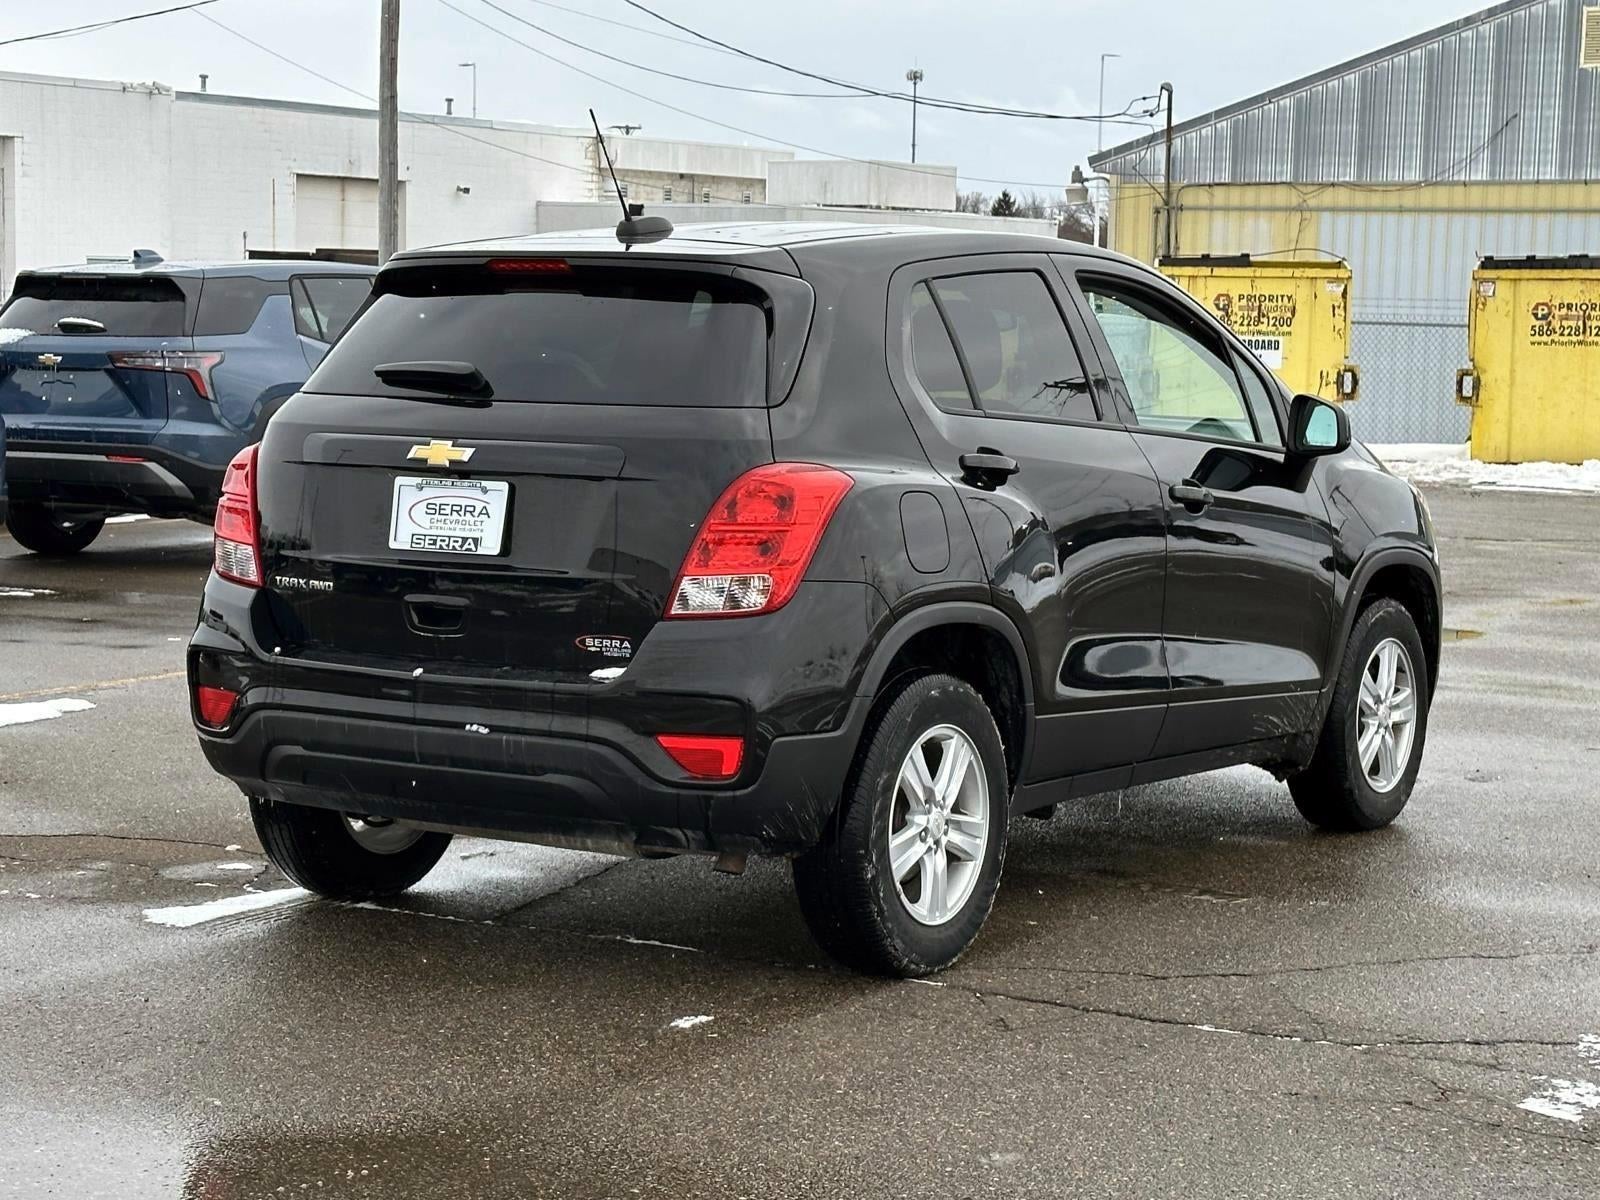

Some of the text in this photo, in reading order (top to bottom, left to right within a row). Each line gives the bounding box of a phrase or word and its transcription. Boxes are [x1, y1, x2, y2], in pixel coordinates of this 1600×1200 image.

[1238, 293, 1293, 303] PRIORITY
[1216, 315, 1292, 327] 86-228-1200
[1242, 339, 1280, 351] BOARD
[425, 502, 491, 519] SERRA
[429, 517, 485, 527] CHEVROLET
[412, 534, 477, 552] SERRA
[275, 575, 334, 591] TRAX AWD
[585, 638, 631, 648] SERRA
